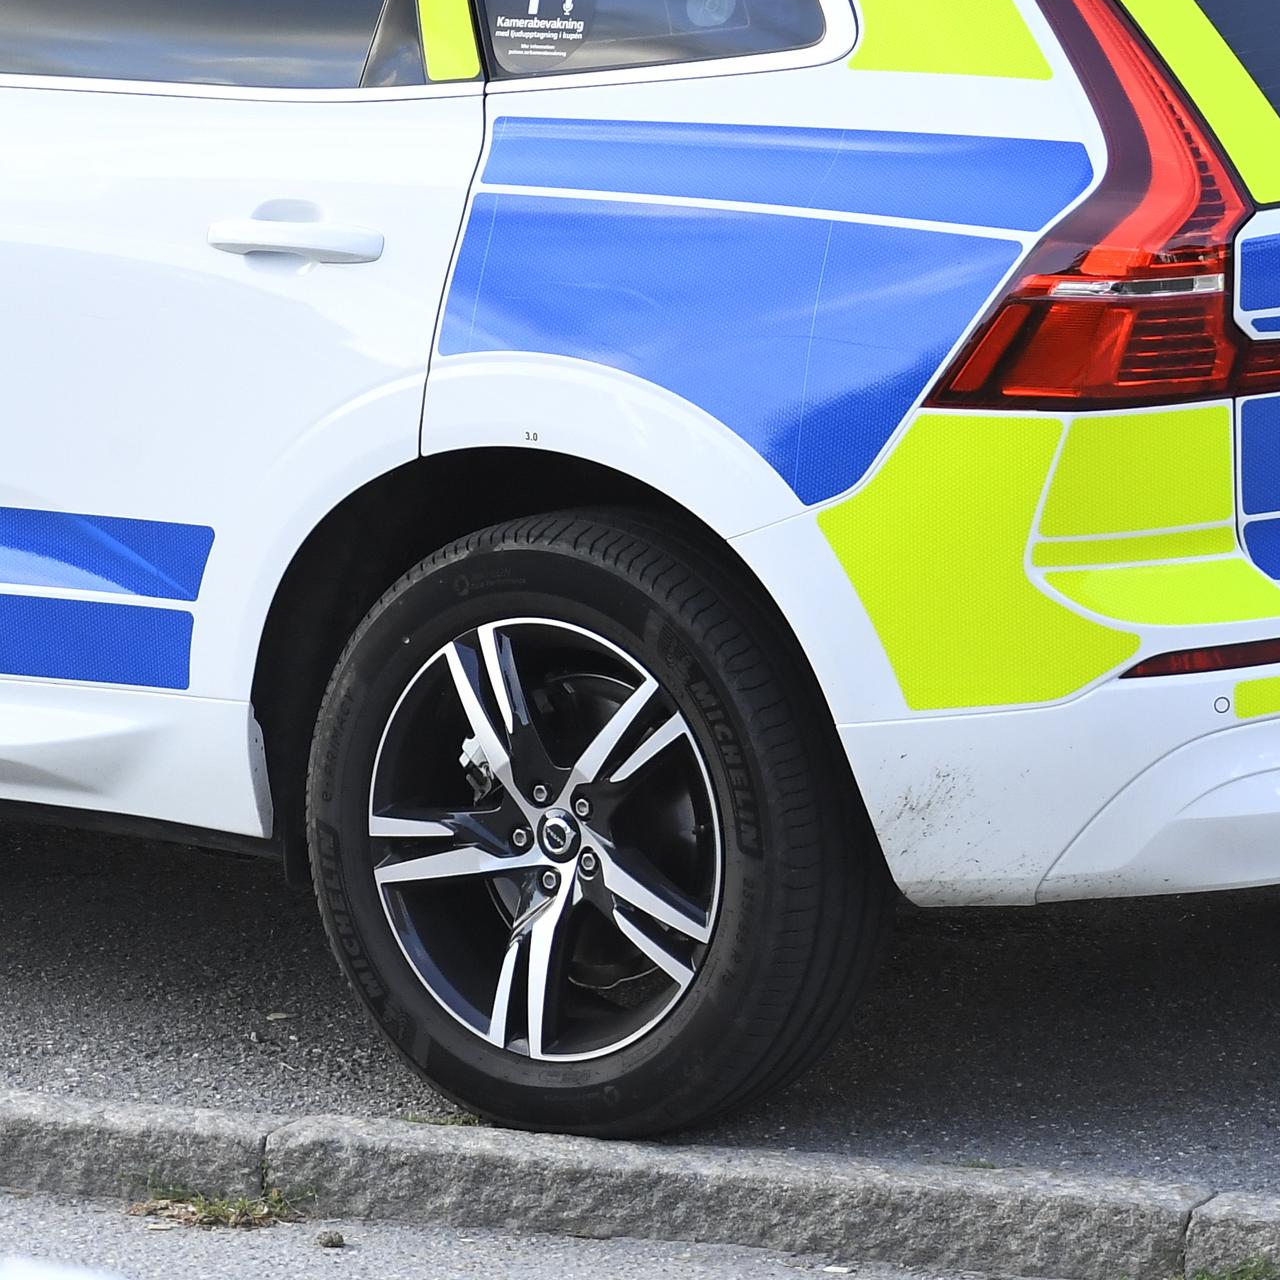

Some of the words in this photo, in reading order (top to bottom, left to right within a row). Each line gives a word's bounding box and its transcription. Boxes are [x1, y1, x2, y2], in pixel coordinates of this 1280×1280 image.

[496, 16, 584, 32] Kamerabevakning
[690, 680, 759, 850] MICHELIN
[319, 829, 385, 999] MICHELIN
